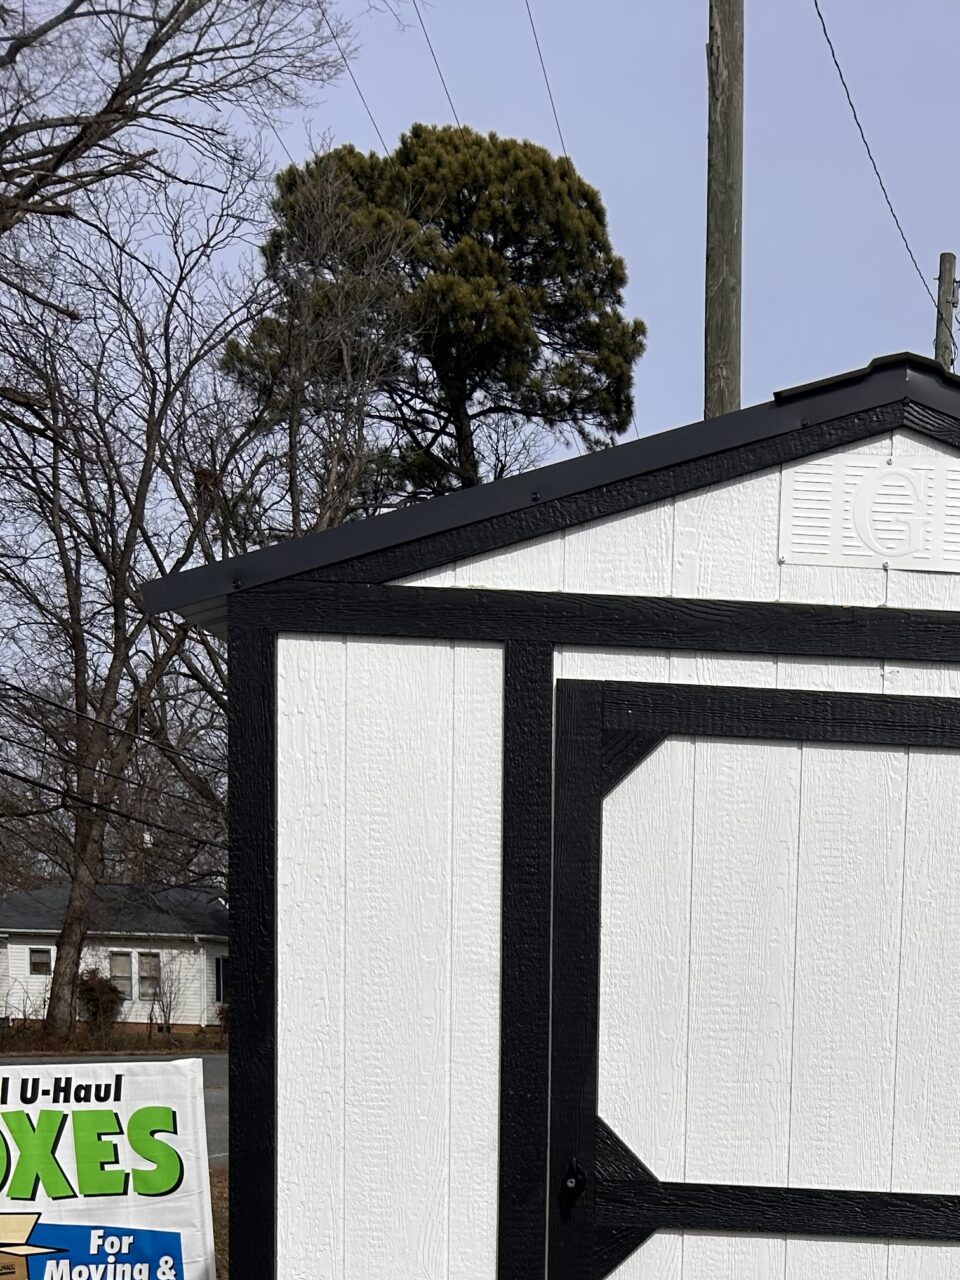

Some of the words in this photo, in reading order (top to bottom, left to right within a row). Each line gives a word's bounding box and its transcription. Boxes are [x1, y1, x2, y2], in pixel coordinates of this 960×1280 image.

[20, 1074, 125, 1105] U-Haul
[0, 1106, 185, 1201] XES
[90, 1229, 134, 1255] For
[156, 1255, 177, 1280] &
